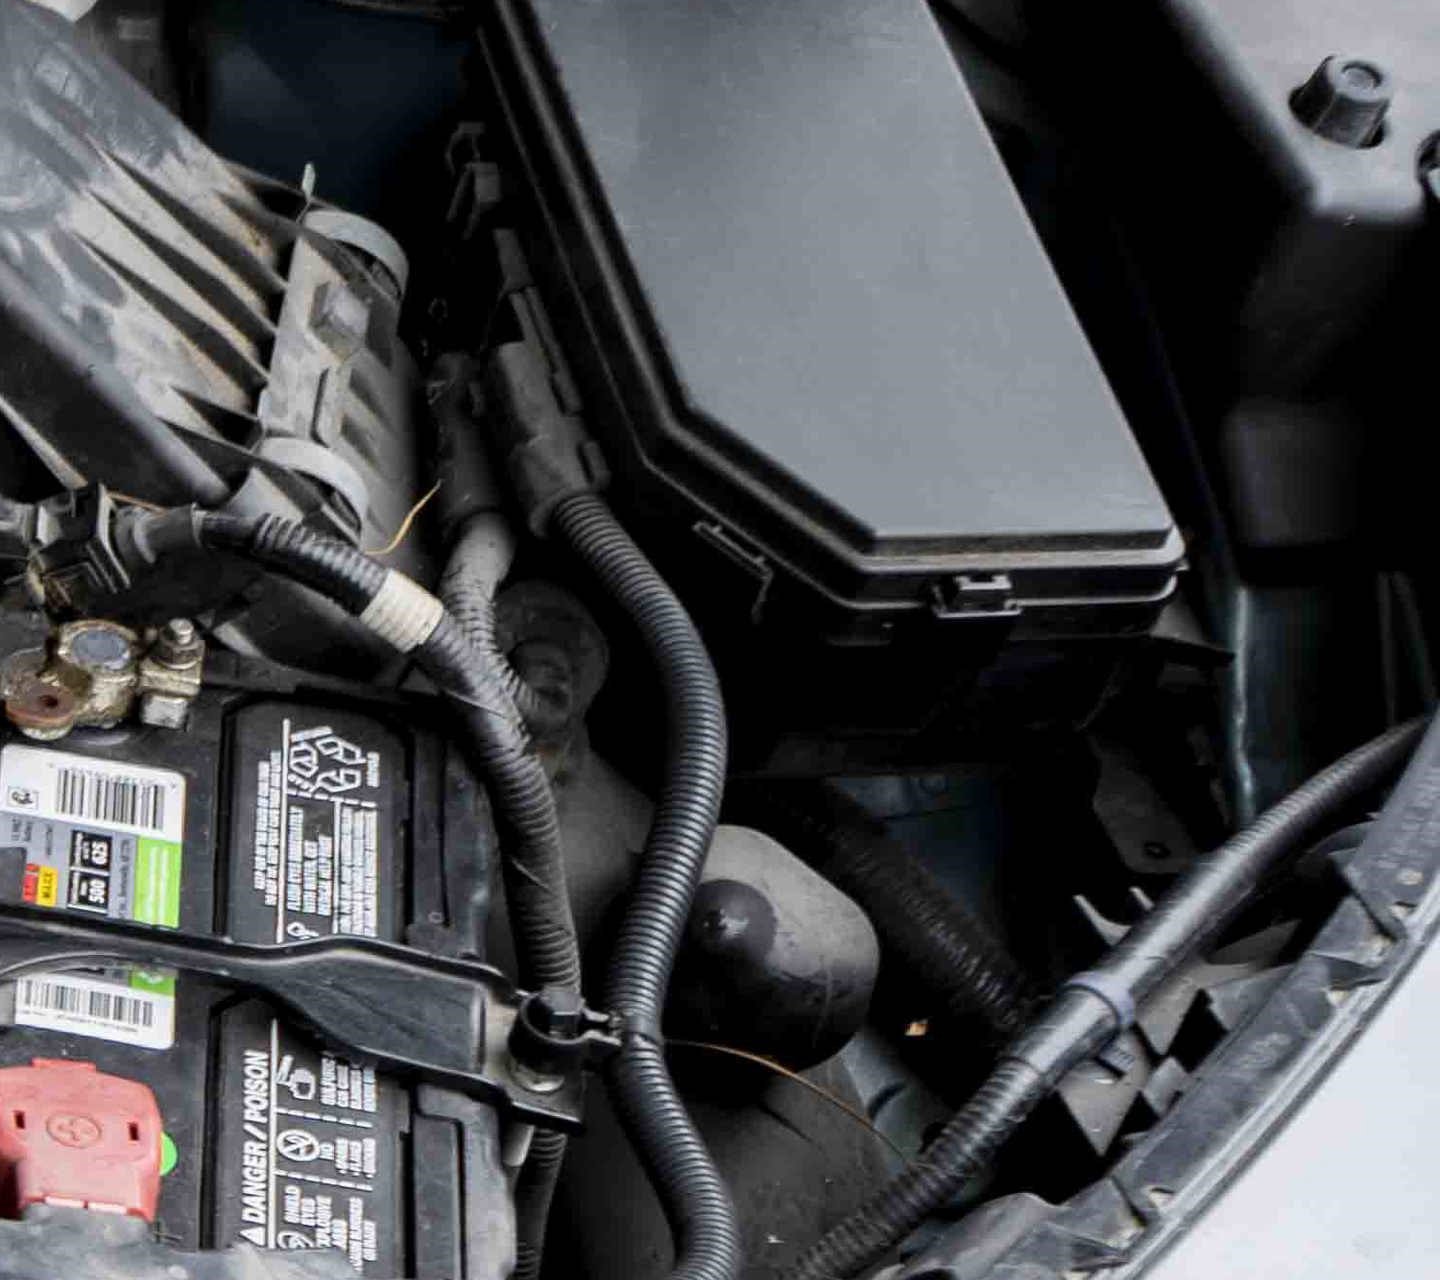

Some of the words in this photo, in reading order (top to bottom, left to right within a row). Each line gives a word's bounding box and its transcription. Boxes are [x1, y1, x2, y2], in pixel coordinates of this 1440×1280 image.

[91, 841, 107, 865] 625
[91, 880, 105, 904] 500
[244, 1049, 268, 1123] POISON
[320, 1144, 334, 1159] NO
[242, 1142, 266, 1224] DANGER
